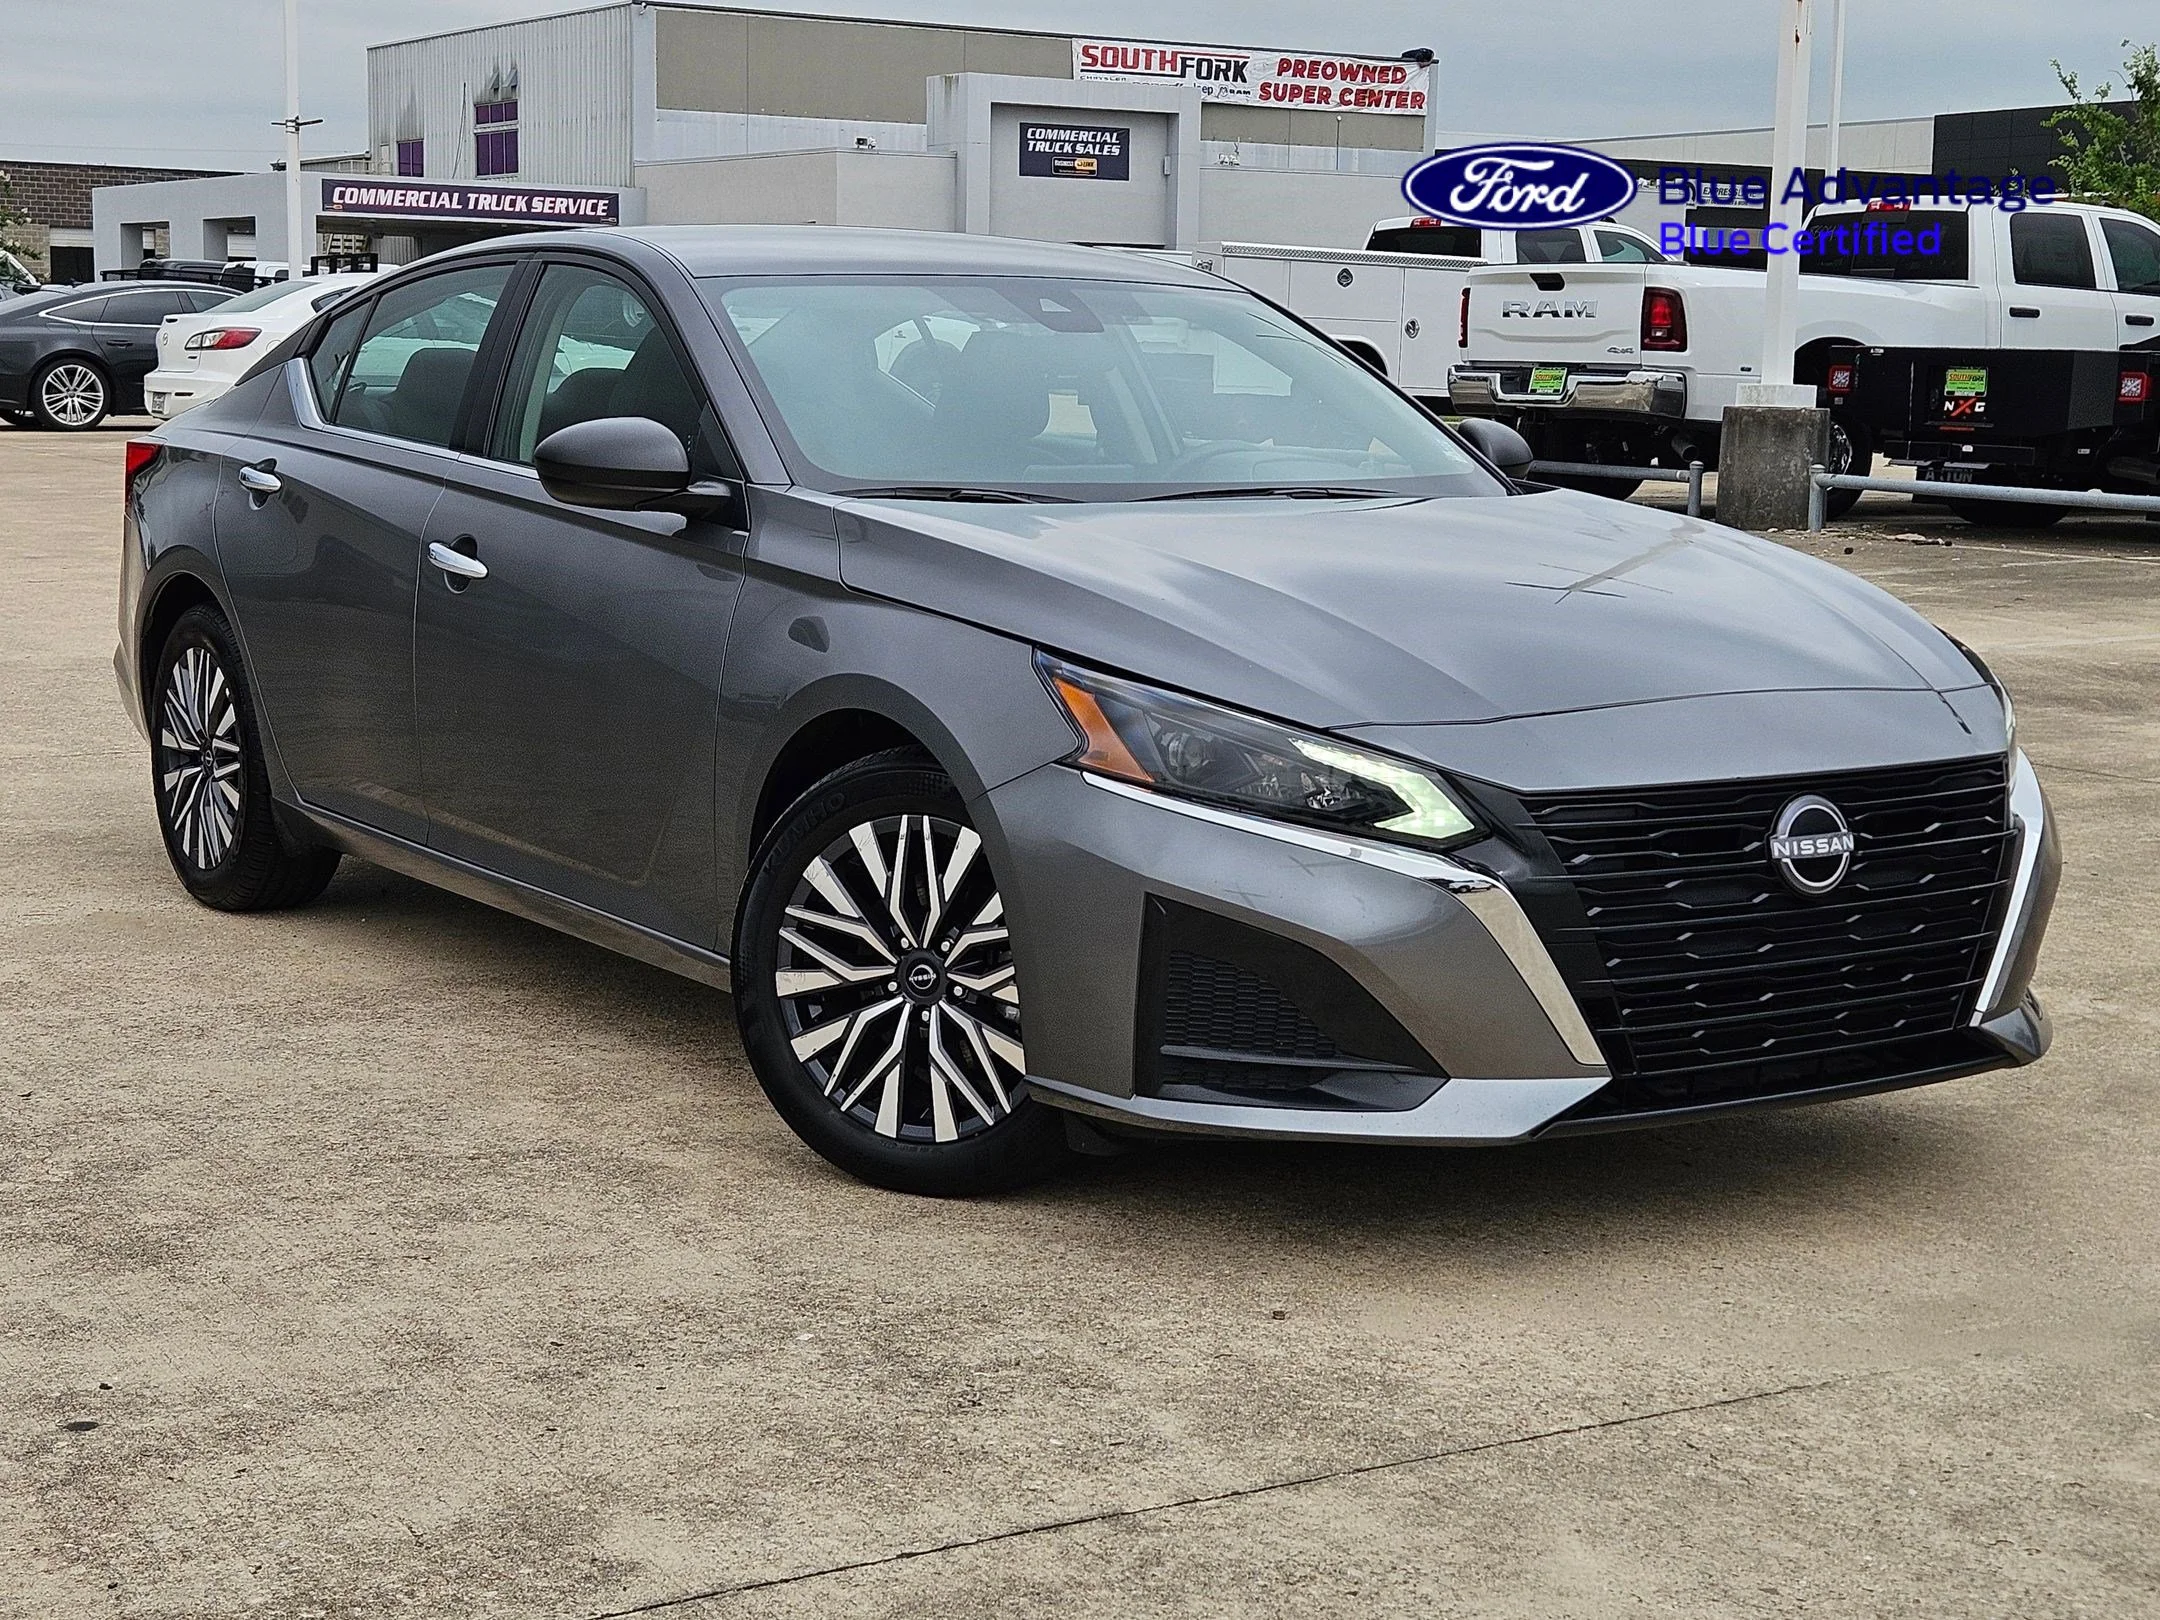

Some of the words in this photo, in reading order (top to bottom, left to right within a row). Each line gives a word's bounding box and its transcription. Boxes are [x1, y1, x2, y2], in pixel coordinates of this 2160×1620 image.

[1081, 45, 1249, 83] SOUTHFORK
[1277, 58, 1407, 84] PREOWNED
[1259, 82, 1332, 105] SUPER
[1339, 88, 1426, 109] CENTER
[1027, 128, 1119, 143] COMMERCIAL
[1028, 140, 1072, 154] TRUCK
[1075, 143, 1120, 156] SALES
[333, 187, 462, 210] COMMERCIAL
[468, 193, 529, 212] TRUCK
[531, 196, 608, 216] SERVICE
[1502, 300, 1597, 318] RAM
[1773, 834, 1853, 856] NISSAN
